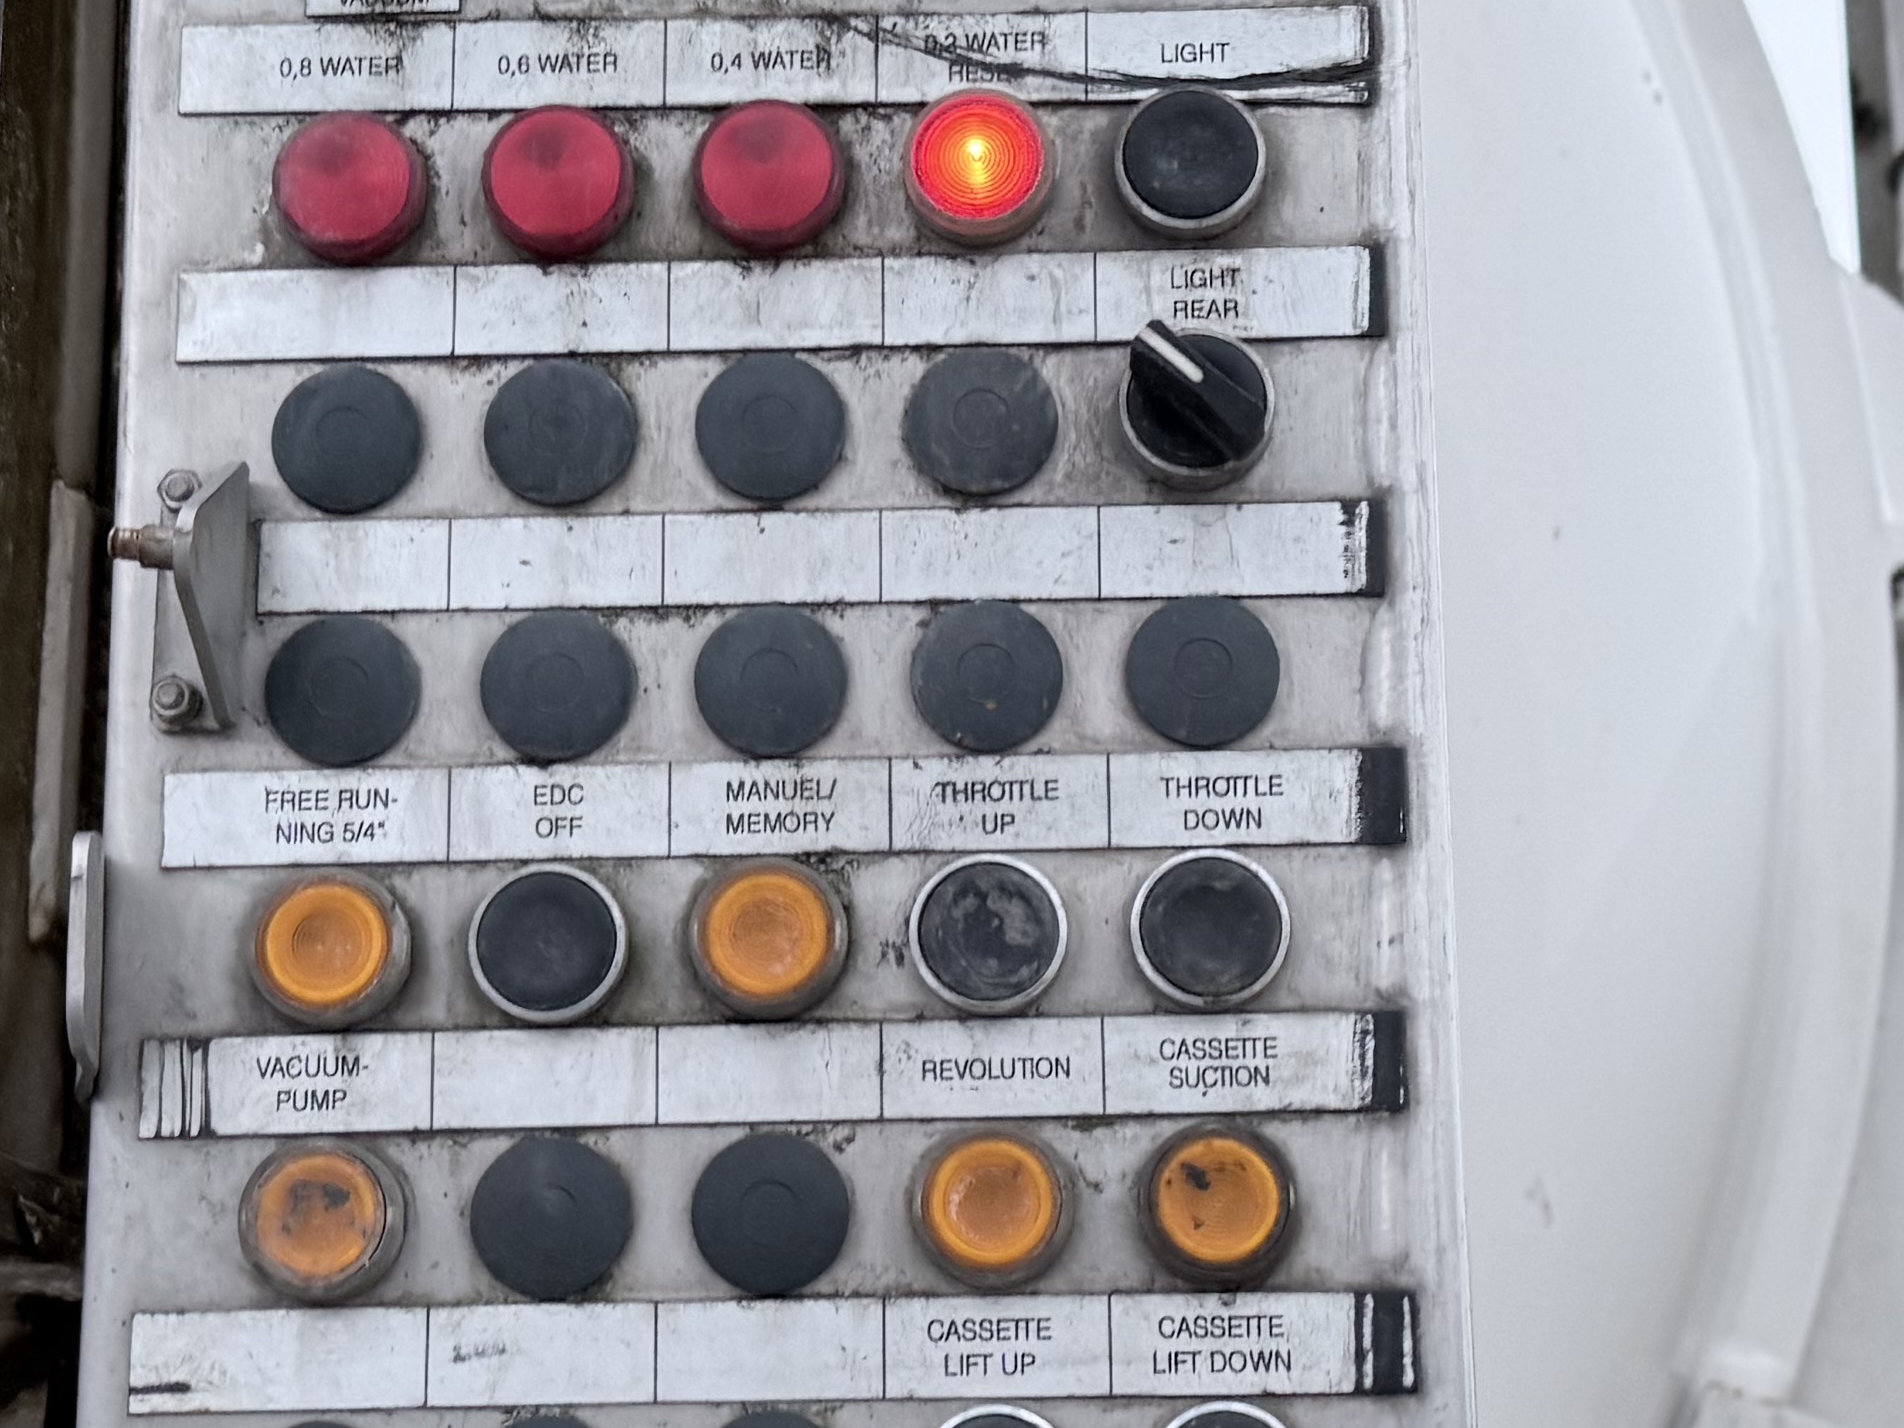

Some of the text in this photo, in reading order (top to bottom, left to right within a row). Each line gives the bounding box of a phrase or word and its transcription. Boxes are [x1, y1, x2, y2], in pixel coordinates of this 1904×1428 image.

[964, 31, 1046, 53] WATER
[1160, 42, 1230, 65] LIGHT
[279, 55, 401, 80] 0,8 WATER
[497, 51, 619, 77] 0,6 WATER
[710, 48, 832, 75] 0,4 WATER
[949, 59, 1016, 83] RESE
[1169, 266, 1241, 291] LIGHT
[1172, 299, 1240, 322] REAR
[264, 787, 399, 813] FREE RUN-
[532, 782, 585, 807] EDC
[726, 777, 836, 802] MANUEL/
[938, 778, 1060, 803] THROTTLE
[1160, 775, 1285, 800] THROTTLE
[534, 816, 584, 839] OFF
[725, 811, 835, 835] MEMORY
[980, 812, 1016, 836] UP
[1183, 807, 1263, 832] DOWN
[275, 821, 335, 845] NING
[1158, 1036, 1278, 1062] CASSETTE
[256, 1055, 370, 1080] VACUUM-
[921, 1056, 1071, 1083] REVOLUTION
[1168, 1065, 1271, 1090] SUCTION
[276, 1088, 348, 1113] PUMP
[926, 1317, 1053, 1343] CASSETTE
[1157, 1313, 1286, 1340] CASSETTE
[943, 1352, 1037, 1378] LIFT UP
[1151, 1348, 1293, 1375] LIFT DOWN
